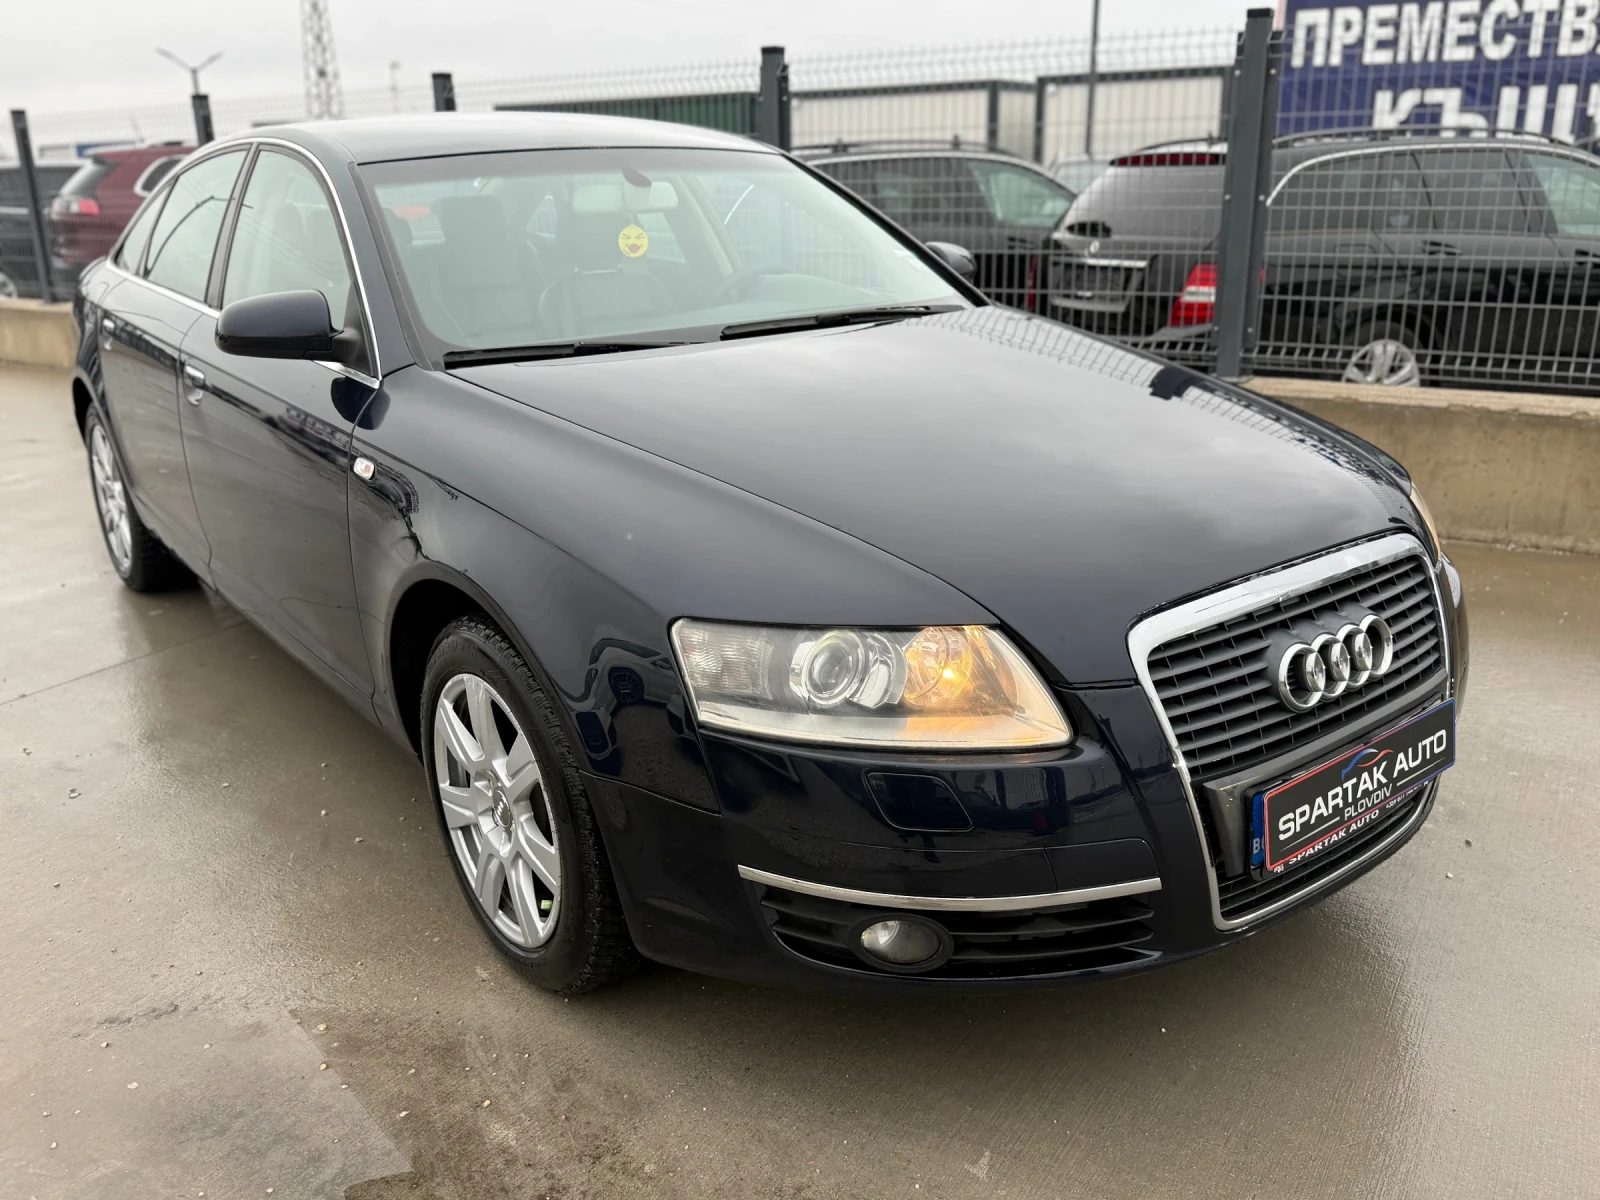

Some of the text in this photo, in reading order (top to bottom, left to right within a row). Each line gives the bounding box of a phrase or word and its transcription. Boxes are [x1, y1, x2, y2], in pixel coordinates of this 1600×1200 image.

[1291, 0, 1600, 67] ПРЕМЕСТВ
[1279, 760, 1388, 841] SPARTAK
[1393, 729, 1447, 778] AUTO
[1344, 783, 1393, 821] PLOVDIV
[1349, 809, 1380, 833] AUTO
